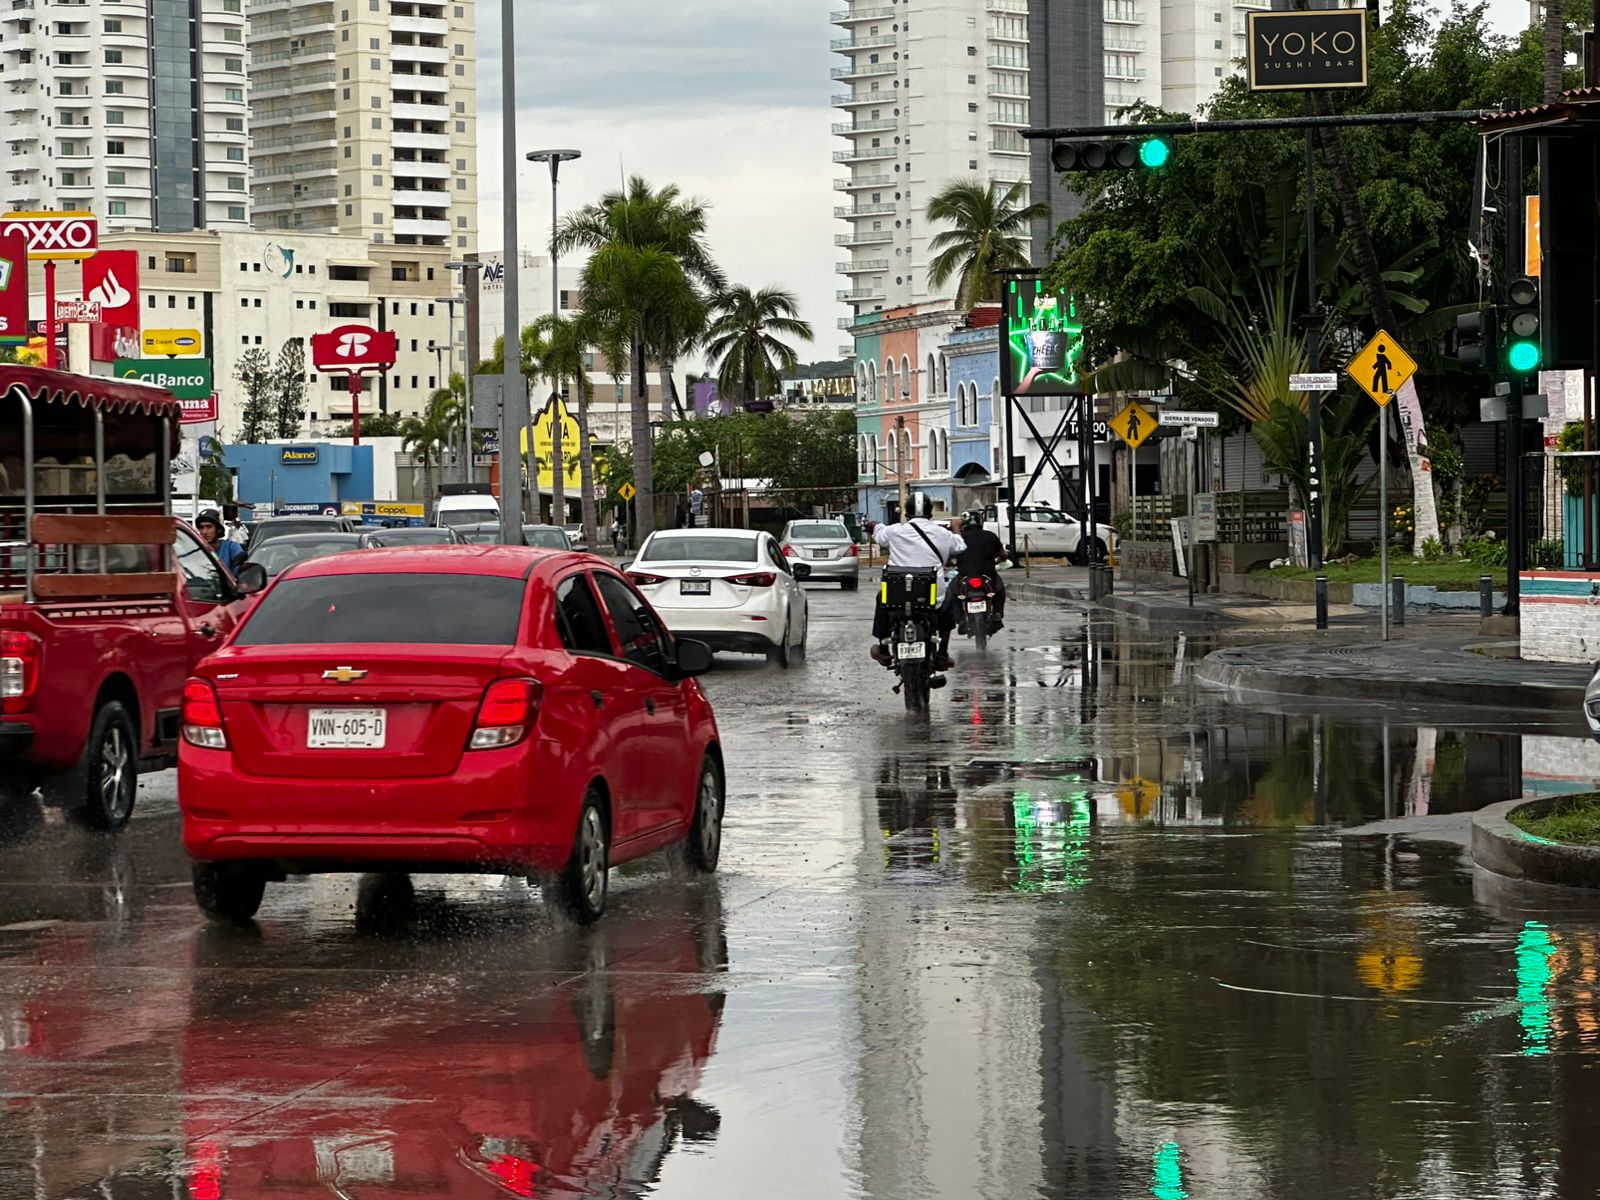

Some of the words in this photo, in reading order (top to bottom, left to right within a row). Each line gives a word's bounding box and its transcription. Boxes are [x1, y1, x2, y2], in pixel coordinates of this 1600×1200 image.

[1260, 30, 1356, 57] YOKO
[1264, 61, 1312, 69] SUSHI
[3, 221, 92, 250] OXXO
[78, 303, 98, 316] 24
[282, 451, 316, 460] Alamo
[378, 505, 408, 515] Coppel
[311, 718, 383, 736] VNN-605-D
